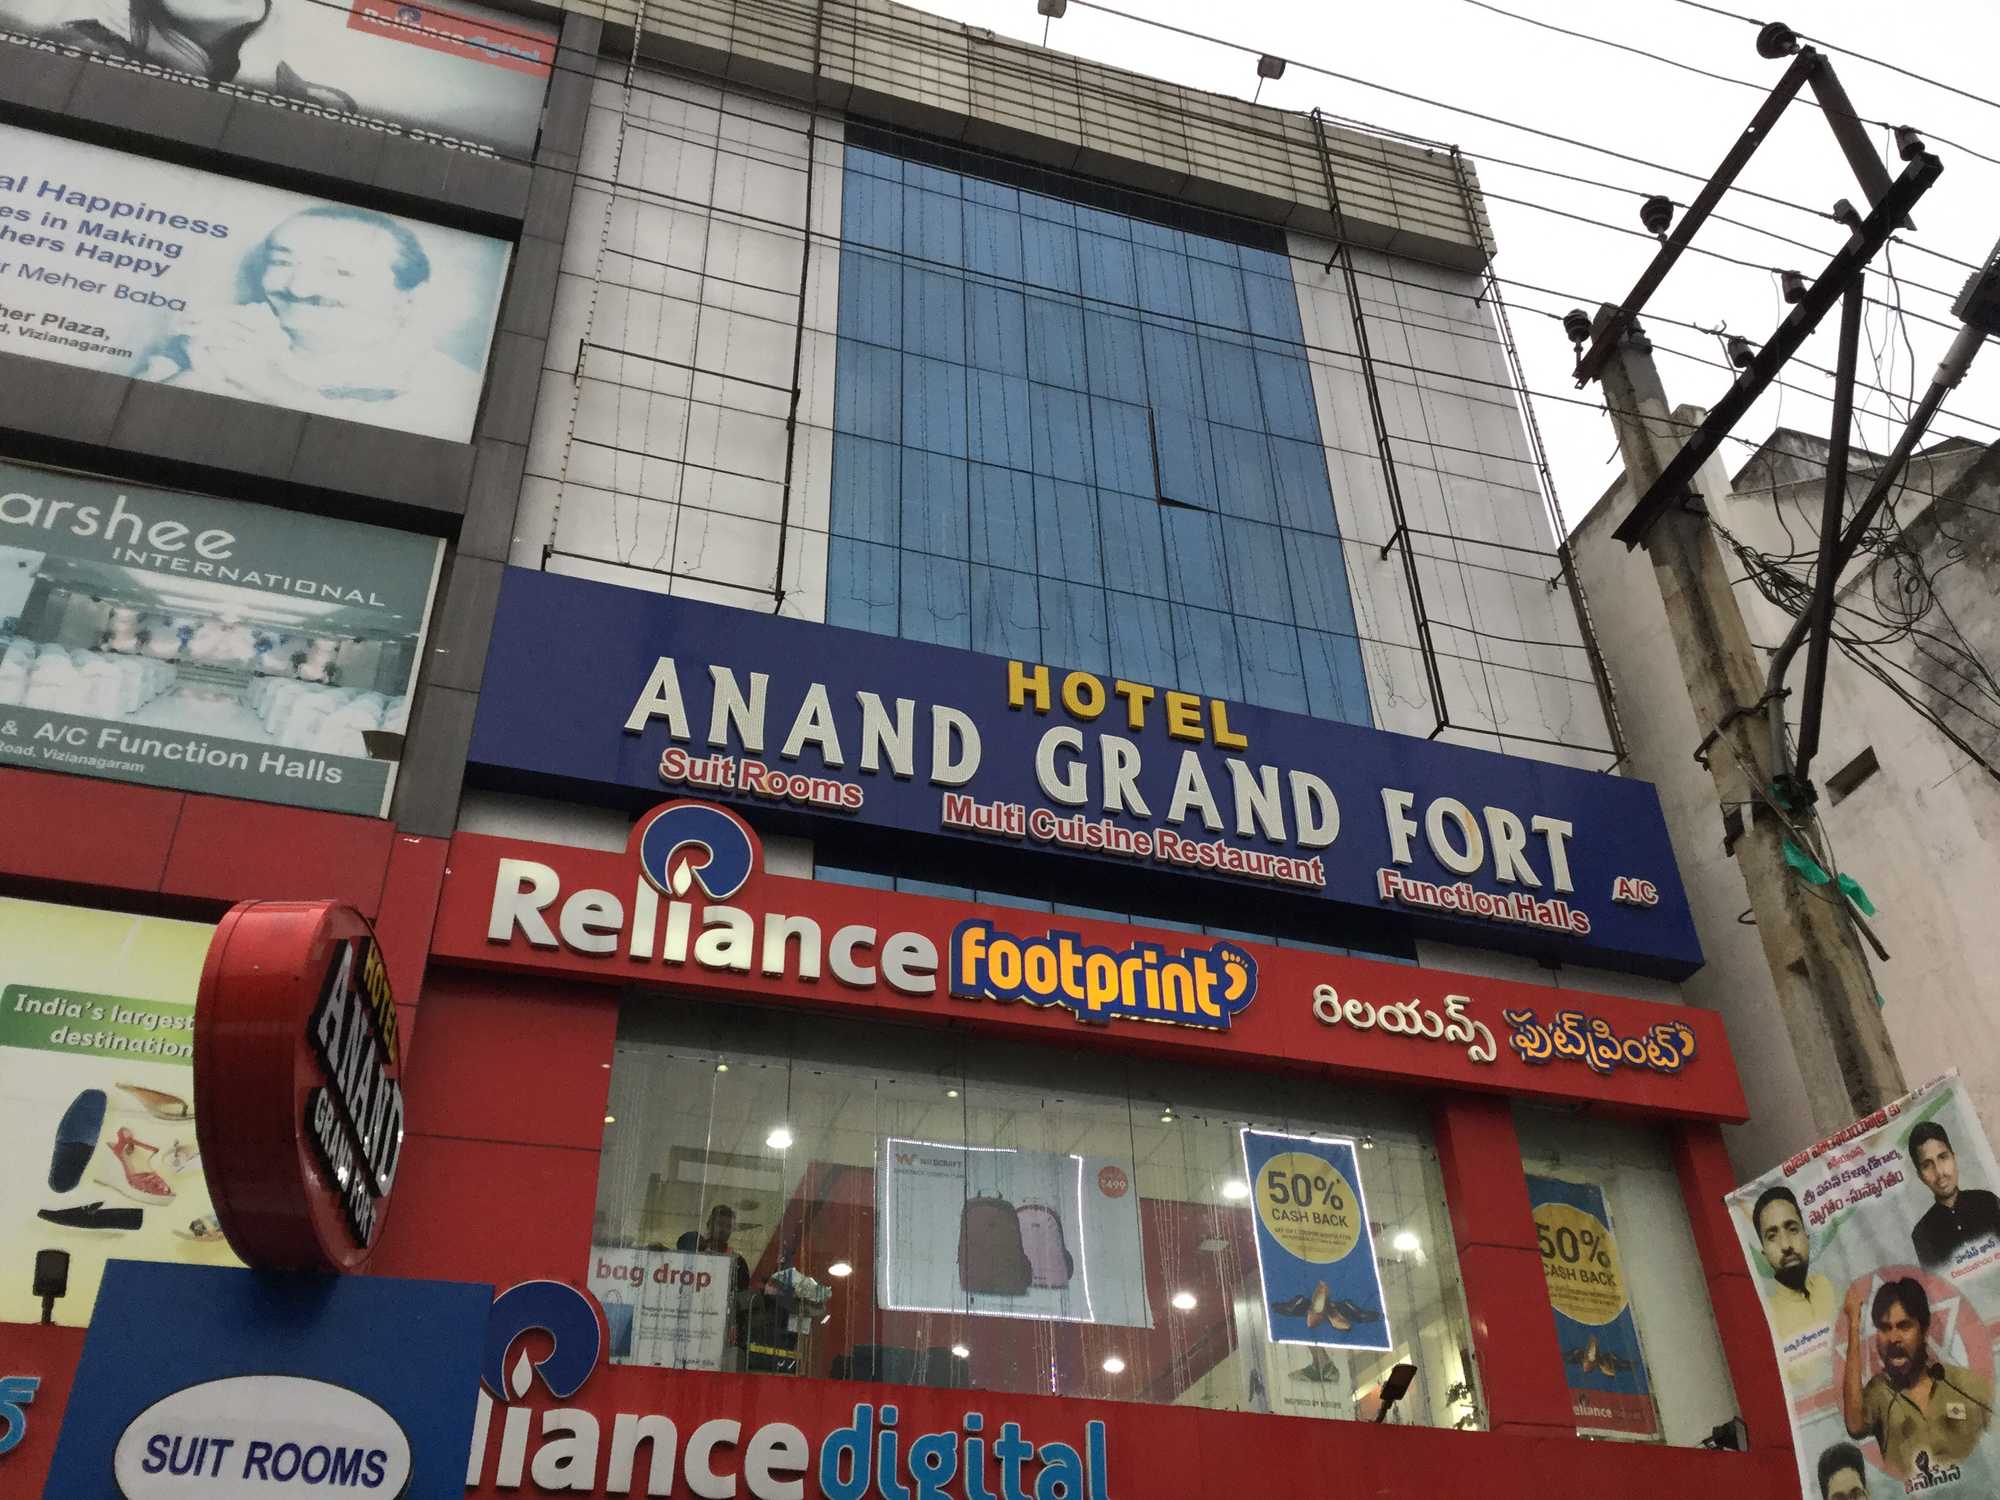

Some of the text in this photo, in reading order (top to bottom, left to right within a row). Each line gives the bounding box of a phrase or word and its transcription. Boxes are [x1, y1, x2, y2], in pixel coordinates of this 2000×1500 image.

[0, 176, 229, 238] al Happiness
[0, 206, 183, 259] es in Making
[18, 264, 106, 294] Meher
[114, 284, 186, 312] Baba
[75, 242, 171, 278] Happy
[19, 326, 133, 358] Vizianagaram
[41, 313, 110, 340] Plaza,
[0, 492, 236, 559] arshee
[112, 547, 385, 607] INTERNATIONAL
[1009, 660, 1248, 749] HOTEL
[34, 722, 88, 745] A/C
[97, 728, 248, 770] Function
[260, 752, 343, 784] Halls
[43, 747, 145, 772] Vizianagaram
[624, 656, 1574, 894] ANAND GRAND FORT
[659, 748, 863, 808] Suit Rooms
[942, 793, 1325, 888] Multi Cuisine Restaurant
[1378, 867, 1590, 936] Function Halls
[1612, 876, 1659, 906] A/C
[487, 857, 1224, 1024] Reliance footprint
[14, 993, 195, 1031] India's largest
[364, 942, 398, 1065] HOTEL
[1313, 984, 1497, 1063] రిలయన్స్
[318, 941, 403, 1197] ANAND
[1271, 1208, 1349, 1228] CASH BACK
[596, 1258, 711, 1293] bag drop
[1580, 1269, 1617, 1287] BACK
[142, 1433, 388, 1488] SUIT ROOMS
[819, 1403, 1107, 1500] digital
